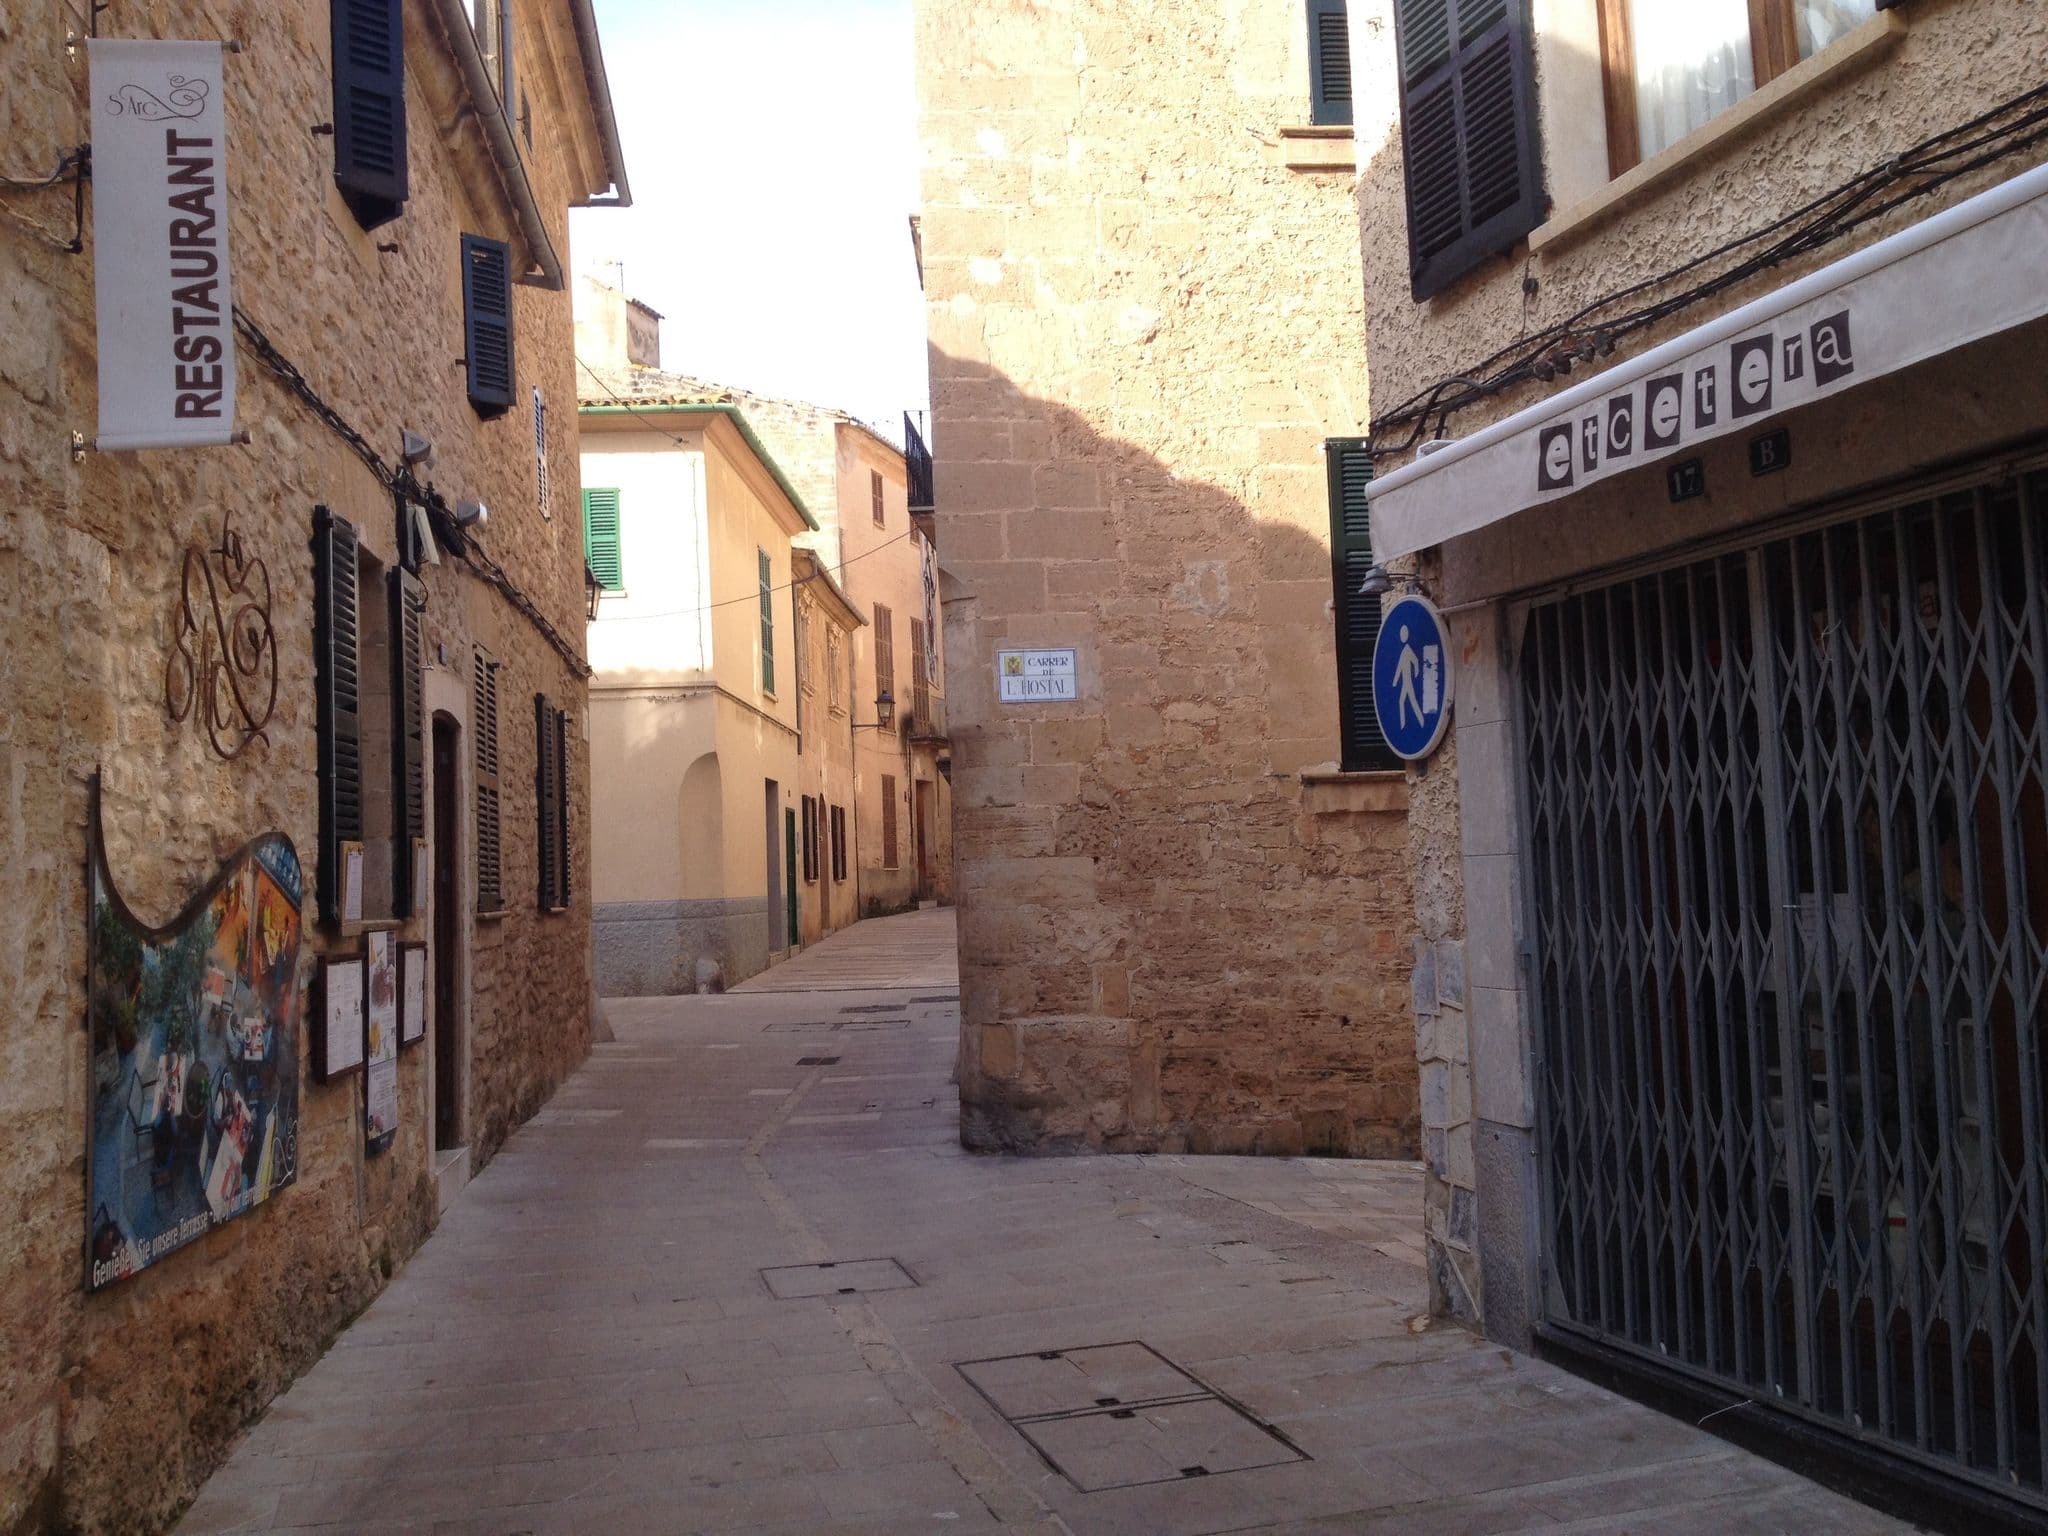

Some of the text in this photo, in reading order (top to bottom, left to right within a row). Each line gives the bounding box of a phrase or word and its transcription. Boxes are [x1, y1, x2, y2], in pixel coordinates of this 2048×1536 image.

[165, 128, 222, 418] RESTAURANT
[1544, 325, 1853, 481] etcetera
[1760, 440, 1776, 468] B
[1027, 656, 1068, 667] CARRER
[138, 1237, 152, 1264] Sie
[152, 1226, 179, 1257] unsere
[179, 1210, 208, 1242] Terrasse
